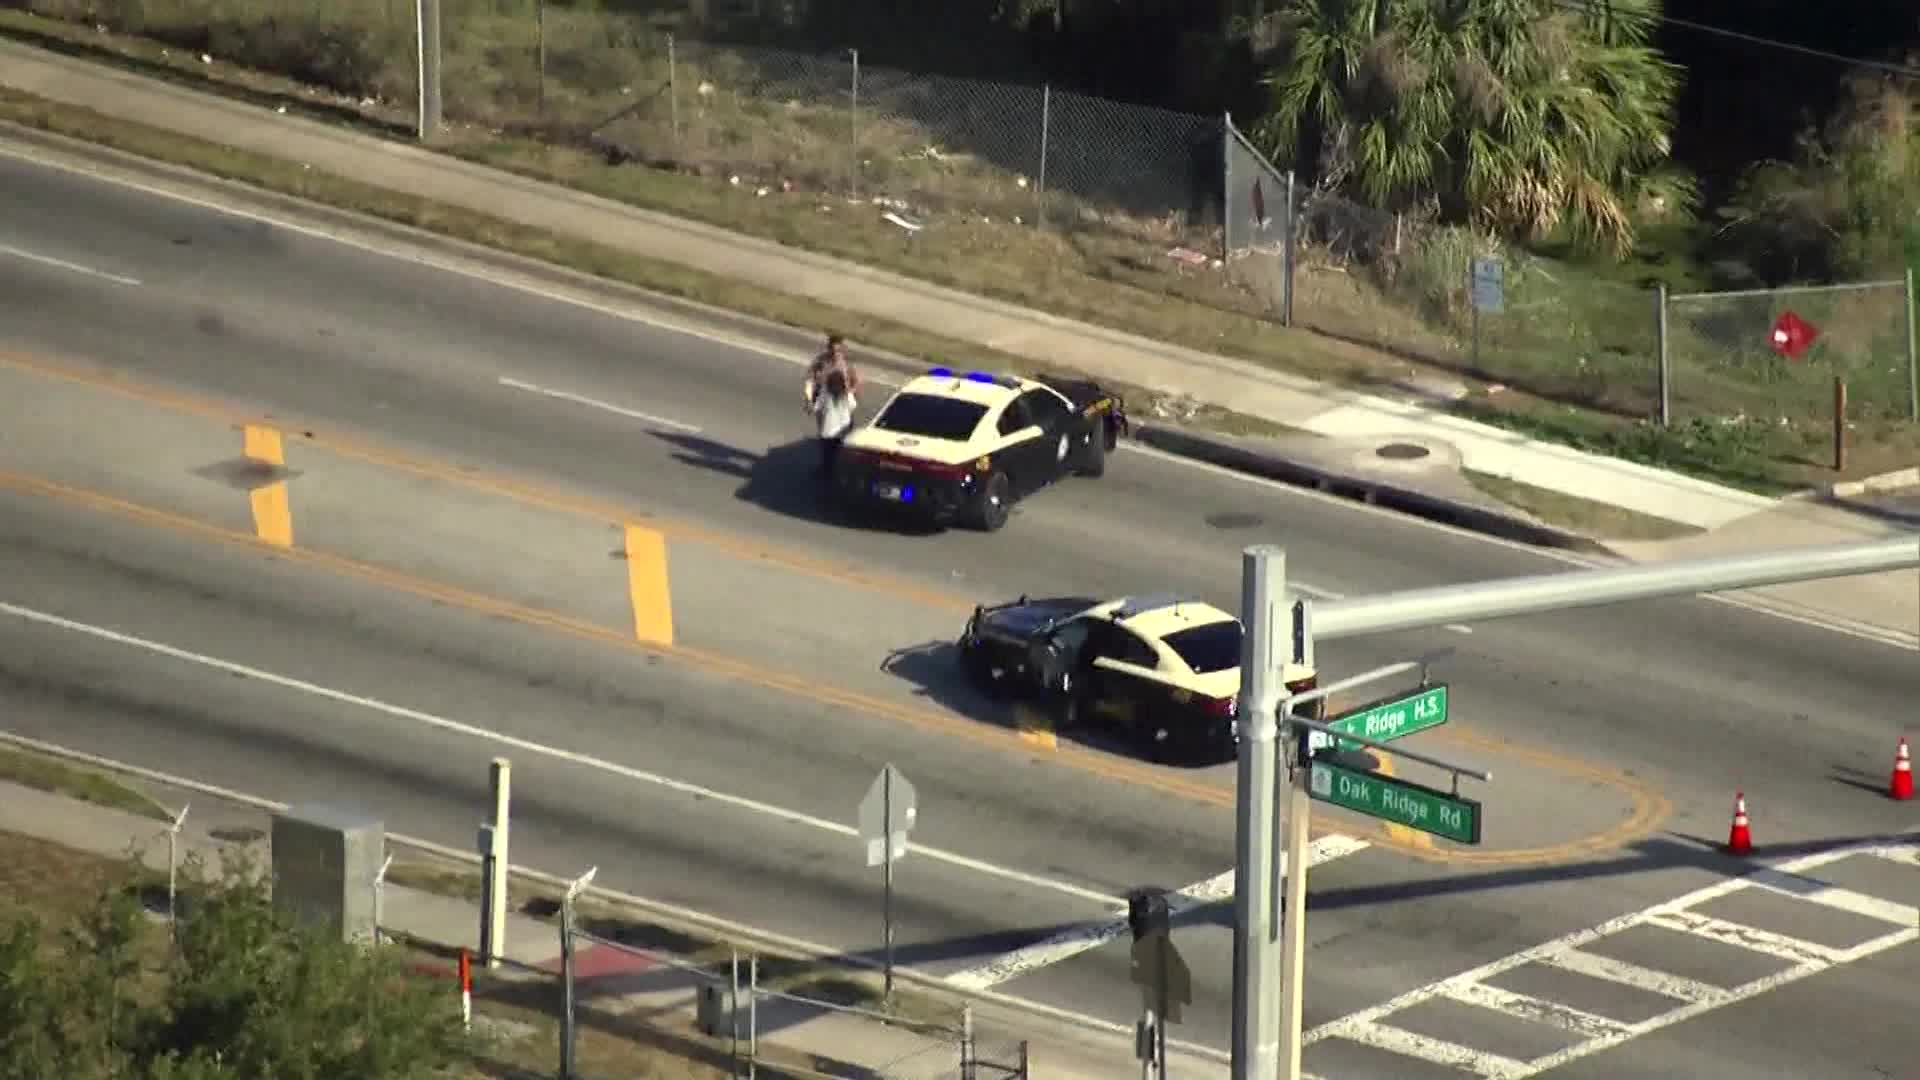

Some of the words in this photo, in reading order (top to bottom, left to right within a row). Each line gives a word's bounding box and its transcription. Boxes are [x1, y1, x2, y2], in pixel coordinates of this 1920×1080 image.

[1365, 709, 1405, 736] Ridge
[1339, 777, 1370, 802] Oak
[1382, 789, 1428, 823] Ridge
[1439, 805, 1461, 828] Rd
